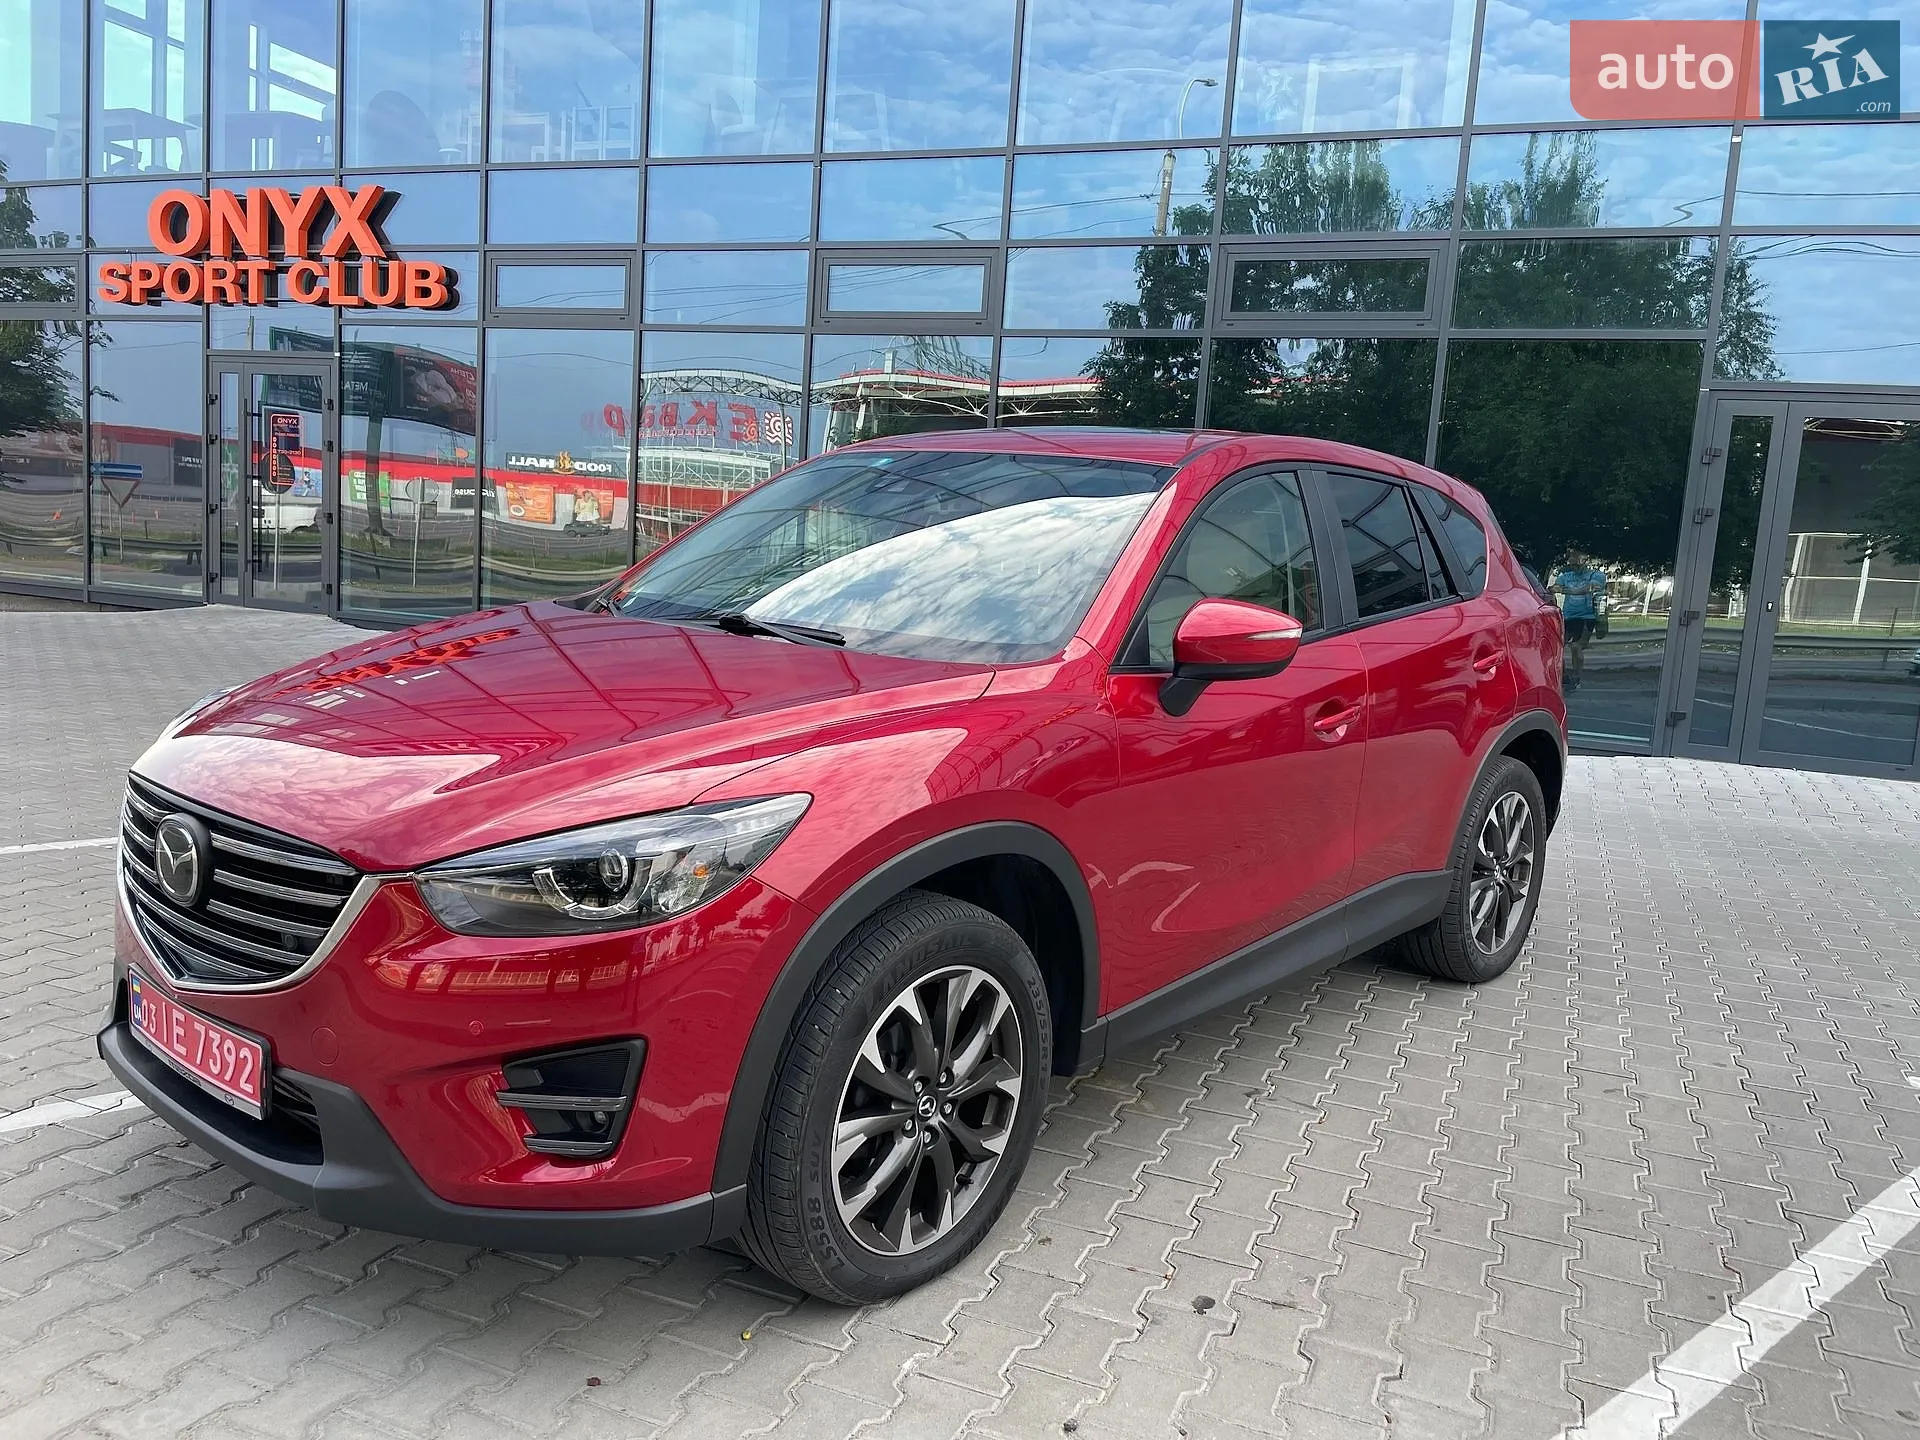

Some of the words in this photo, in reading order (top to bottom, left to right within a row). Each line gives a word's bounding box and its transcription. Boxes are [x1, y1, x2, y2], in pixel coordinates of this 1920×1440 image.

[148, 185, 386, 258] ONYX
[98, 259, 277, 305] SPORT
[287, 260, 449, 309] CLUB
[278, 417, 297, 425] ONYX
[133, 1003, 142, 1022] UA
[141, 998, 157, 1036] 03
[161, 1000, 188, 1059] IE
[193, 1024, 255, 1095] 7392
[807, 1196, 846, 1274] LS588
